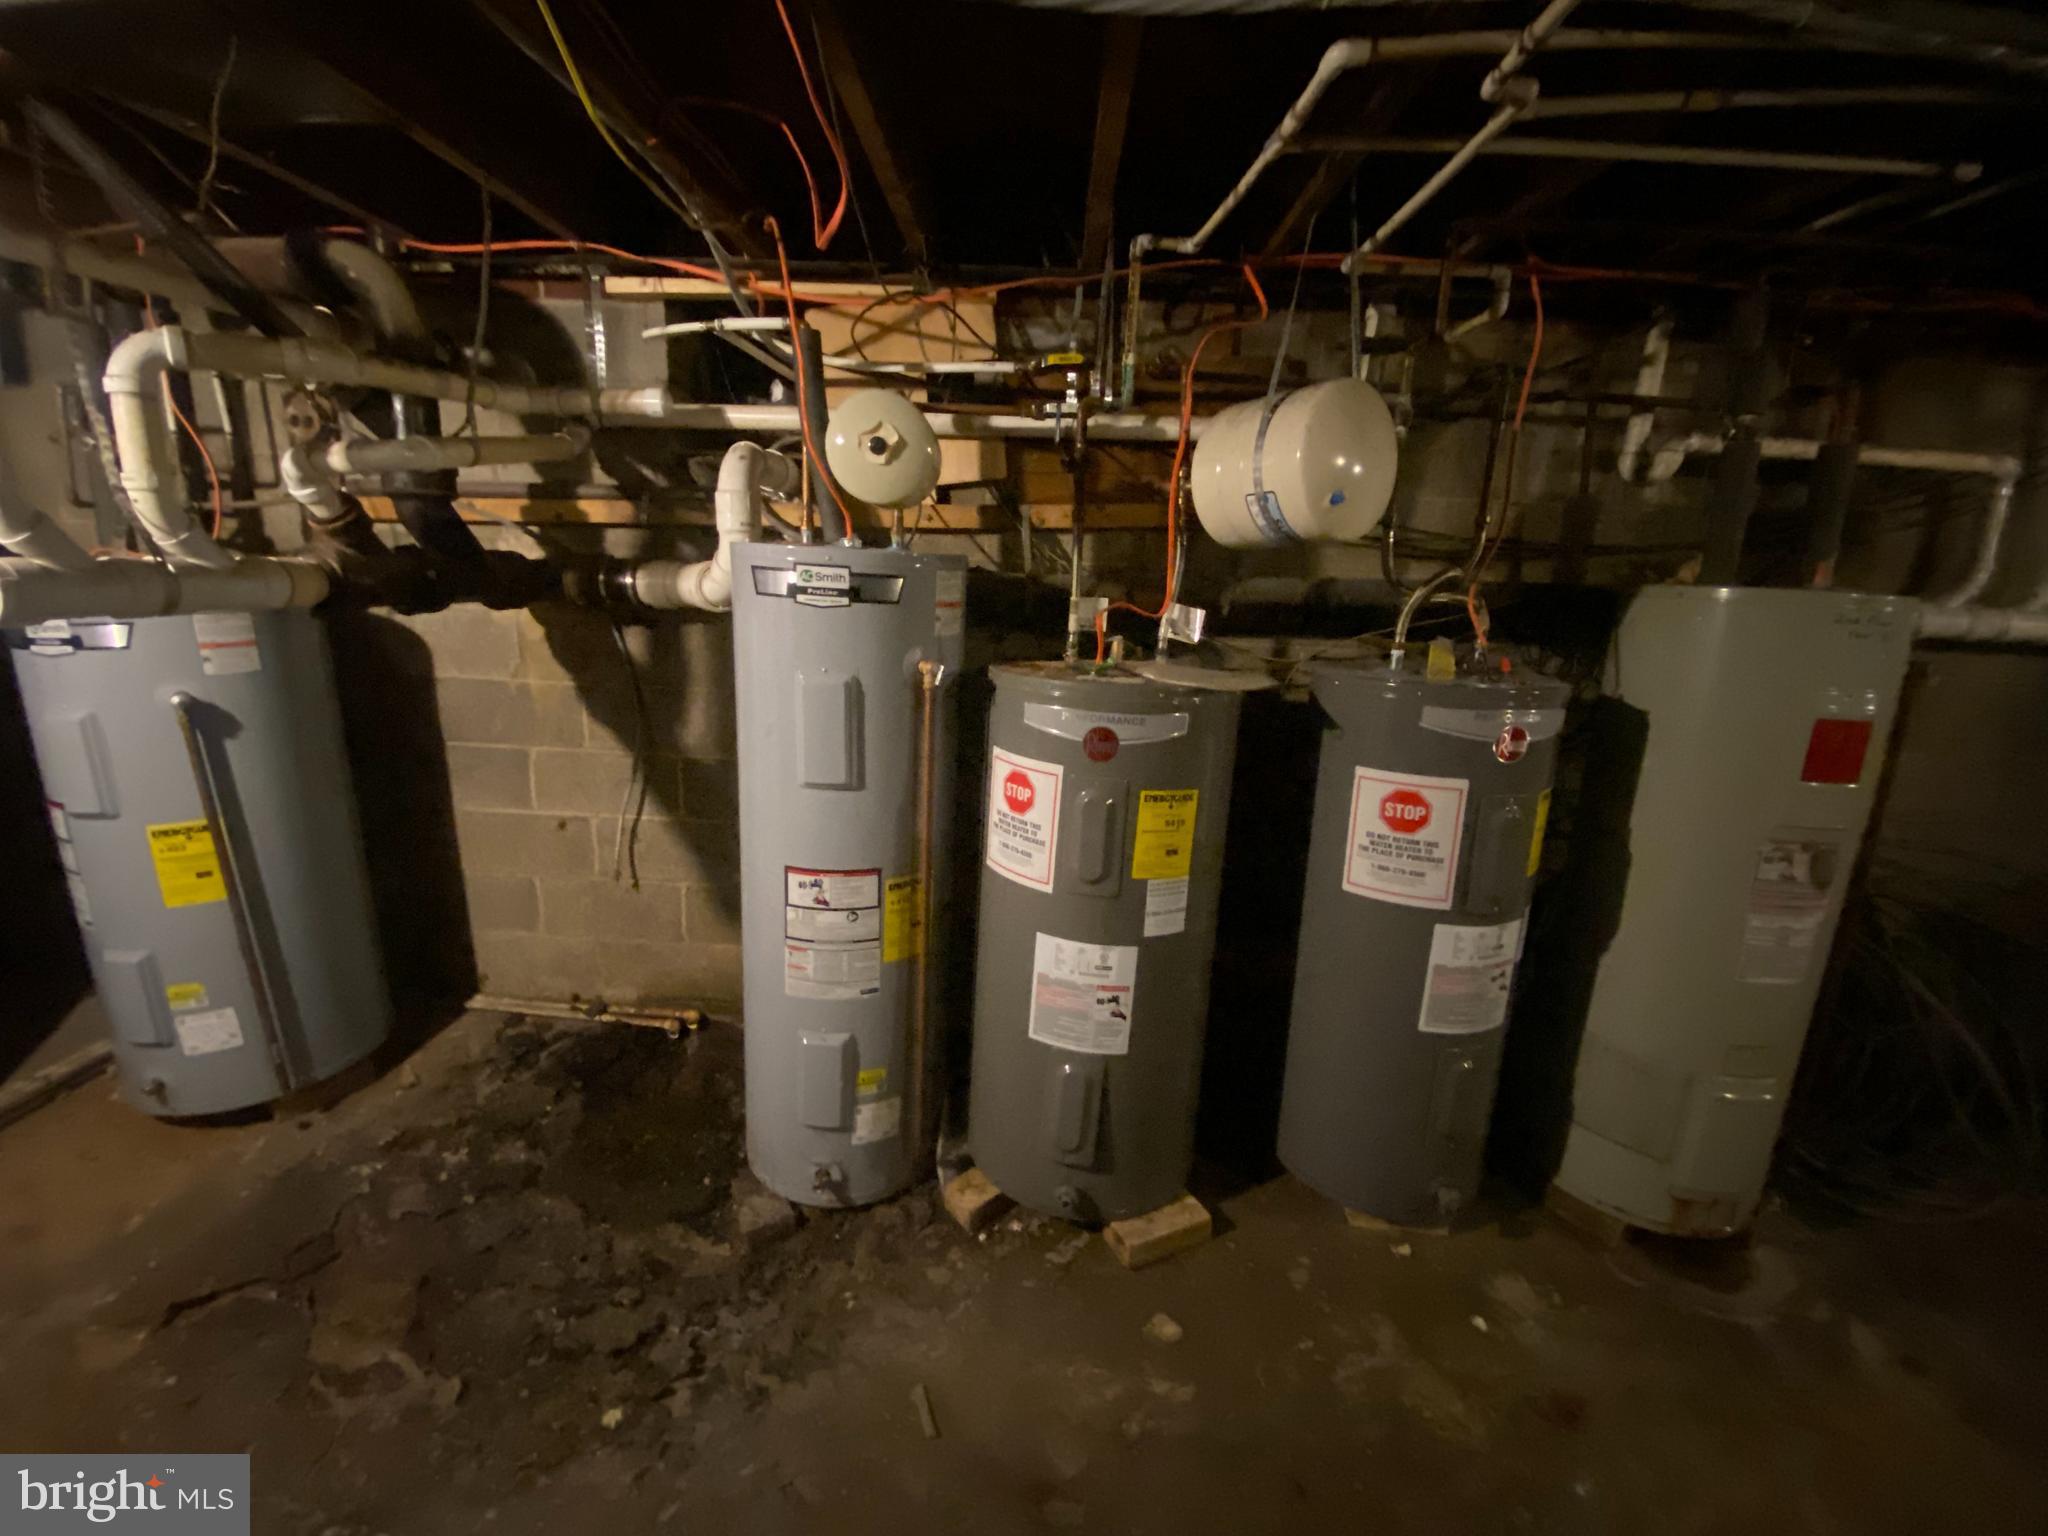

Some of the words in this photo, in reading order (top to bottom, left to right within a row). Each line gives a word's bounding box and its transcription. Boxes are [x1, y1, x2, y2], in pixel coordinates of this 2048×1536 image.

[815, 571, 847, 583] Smith
[1005, 781, 1032, 802] STOP
[1384, 801, 1426, 821] STOP
[1377, 833, 1391, 841] NOT
[1393, 836, 1421, 846] RETURN
[1371, 847, 1393, 857] PLACE
[1395, 845, 1422, 853] HEATER
